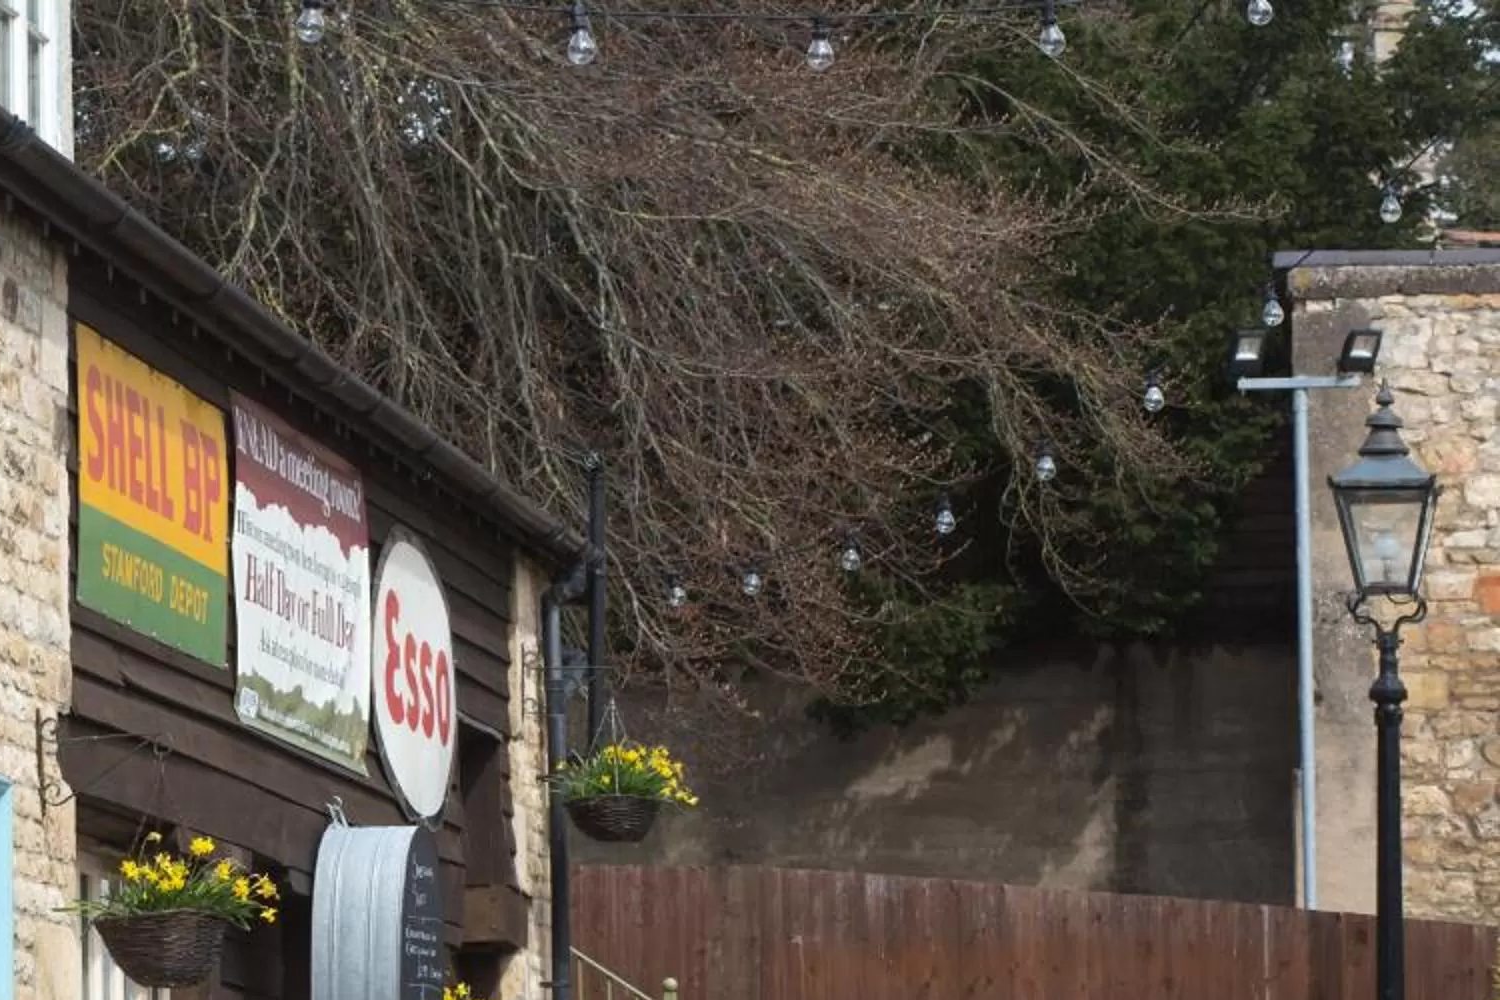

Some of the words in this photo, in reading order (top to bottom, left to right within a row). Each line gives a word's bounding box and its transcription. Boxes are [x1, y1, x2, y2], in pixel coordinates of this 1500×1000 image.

[86, 364, 175, 522] SHELL
[180, 417, 221, 544] BP
[280, 444, 287, 480] a
[287, 451, 330, 518] meeting
[102, 542, 165, 605] STAMFORD
[170, 574, 209, 626] DEPOT
[244, 552, 274, 613] Half
[276, 567, 296, 622] Day
[298, 597, 310, 633] or
[311, 589, 335, 644] Full
[336, 601, 355, 654] Day
